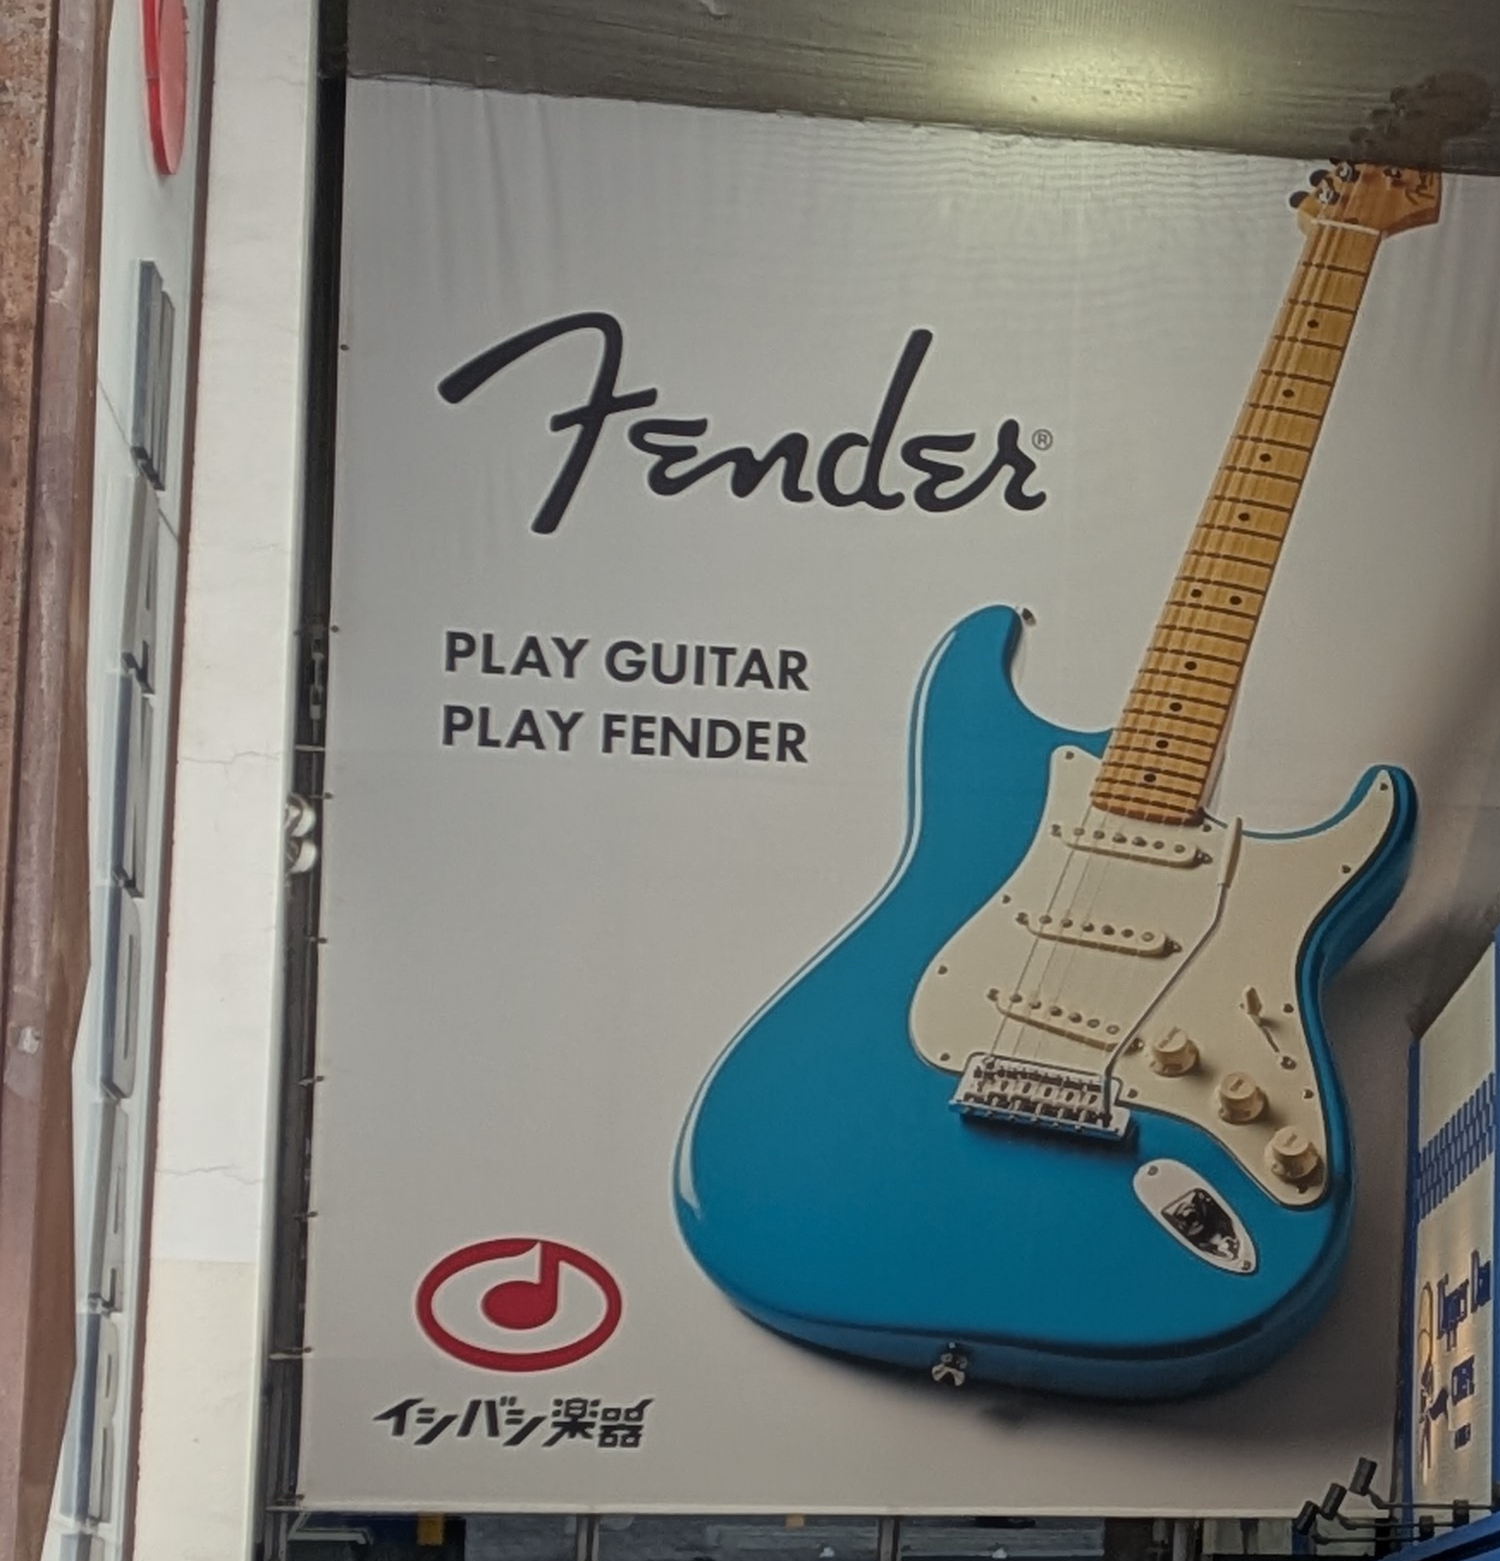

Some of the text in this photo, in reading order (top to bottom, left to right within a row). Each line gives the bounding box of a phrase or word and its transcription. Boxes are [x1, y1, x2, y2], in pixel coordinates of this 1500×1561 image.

[438, 312, 1047, 534] Fender
[444, 631, 809, 692] PLAY GUITAR
[442, 705, 808, 763] PLAY FENDER
[372, 1396, 654, 1448] イシバシ楽器
